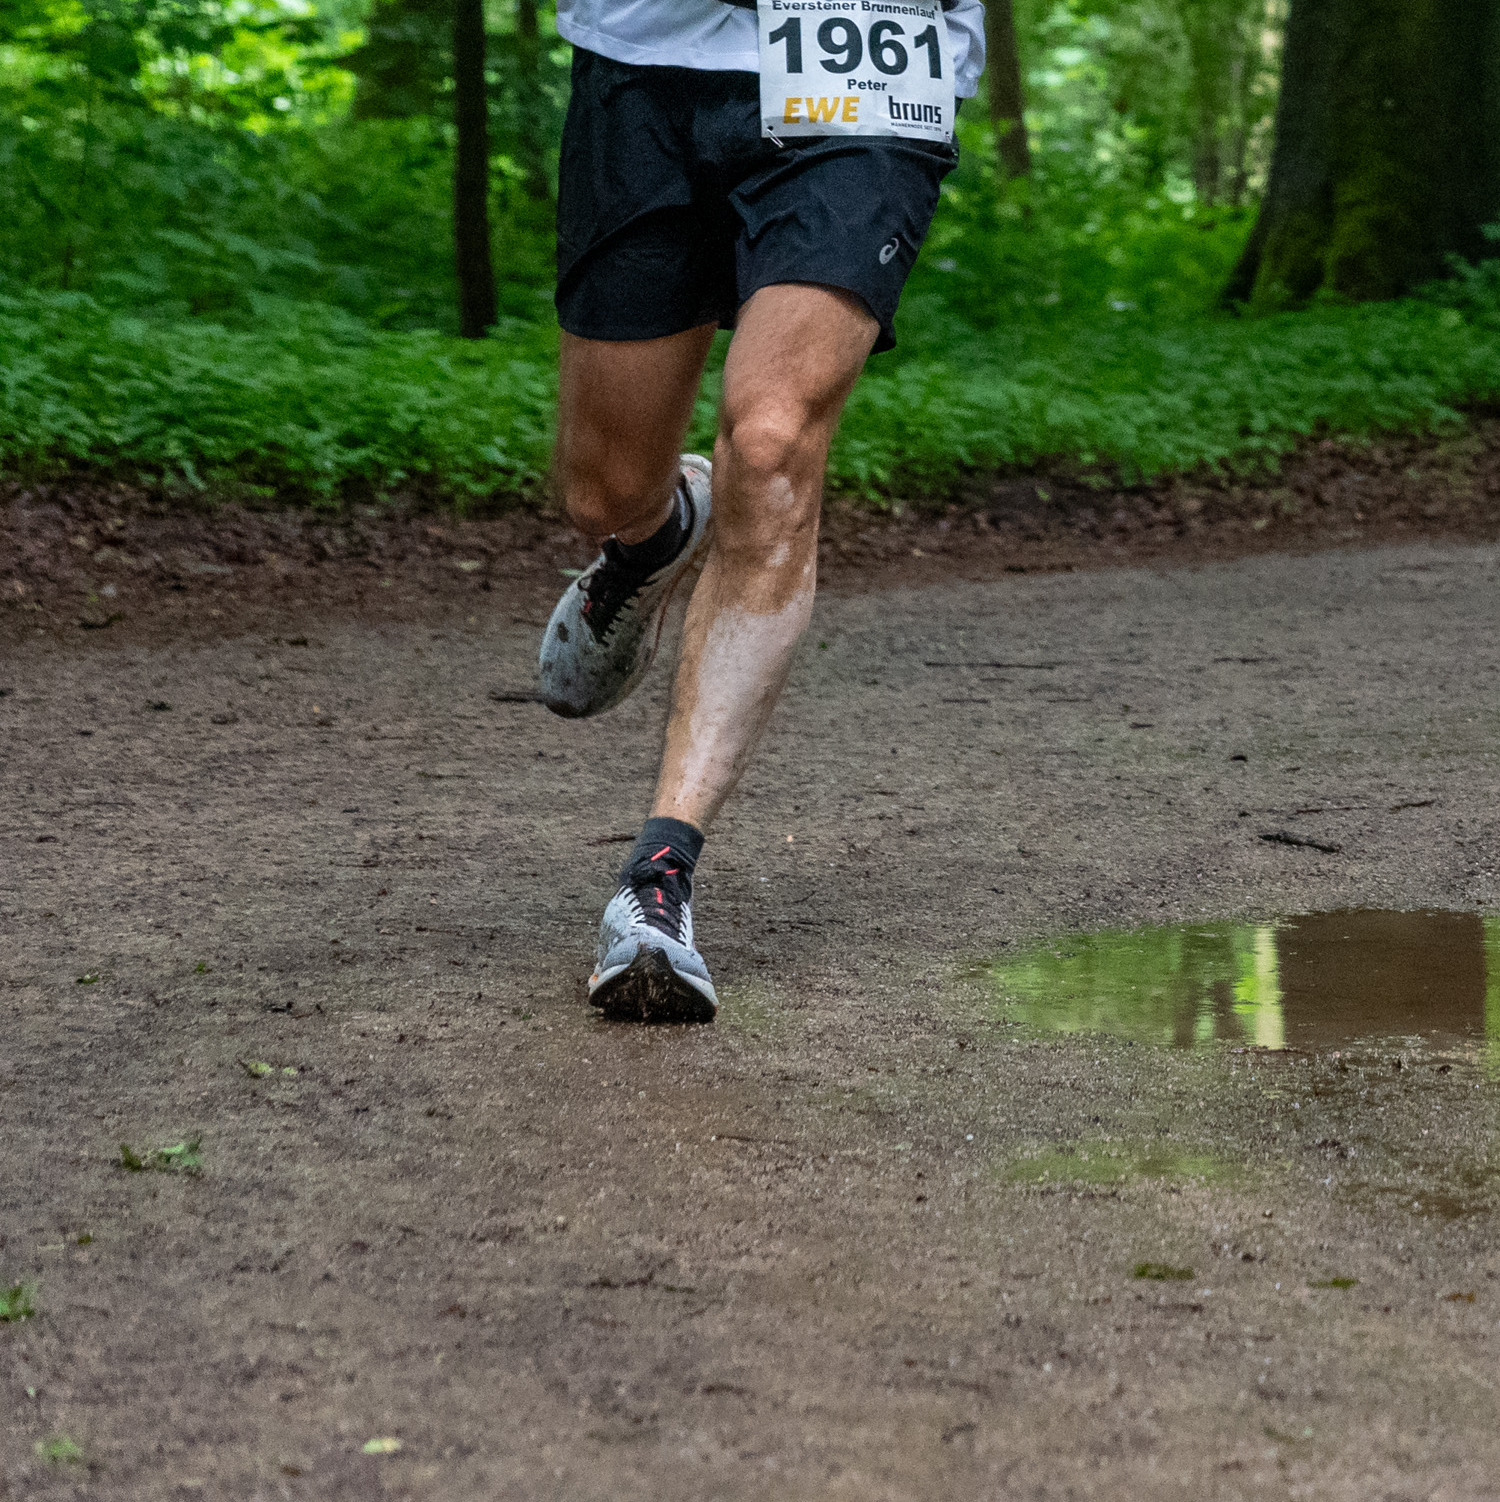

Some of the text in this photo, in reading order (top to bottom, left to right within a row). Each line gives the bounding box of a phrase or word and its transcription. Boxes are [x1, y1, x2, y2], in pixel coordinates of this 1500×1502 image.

[772, 0, 936, 20] Everstener Brunnenlauf
[769, 17, 942, 79] 1961
[847, 79, 888, 91] Peter
[783, 97, 860, 124] EWE
[888, 95, 942, 124] bruns
